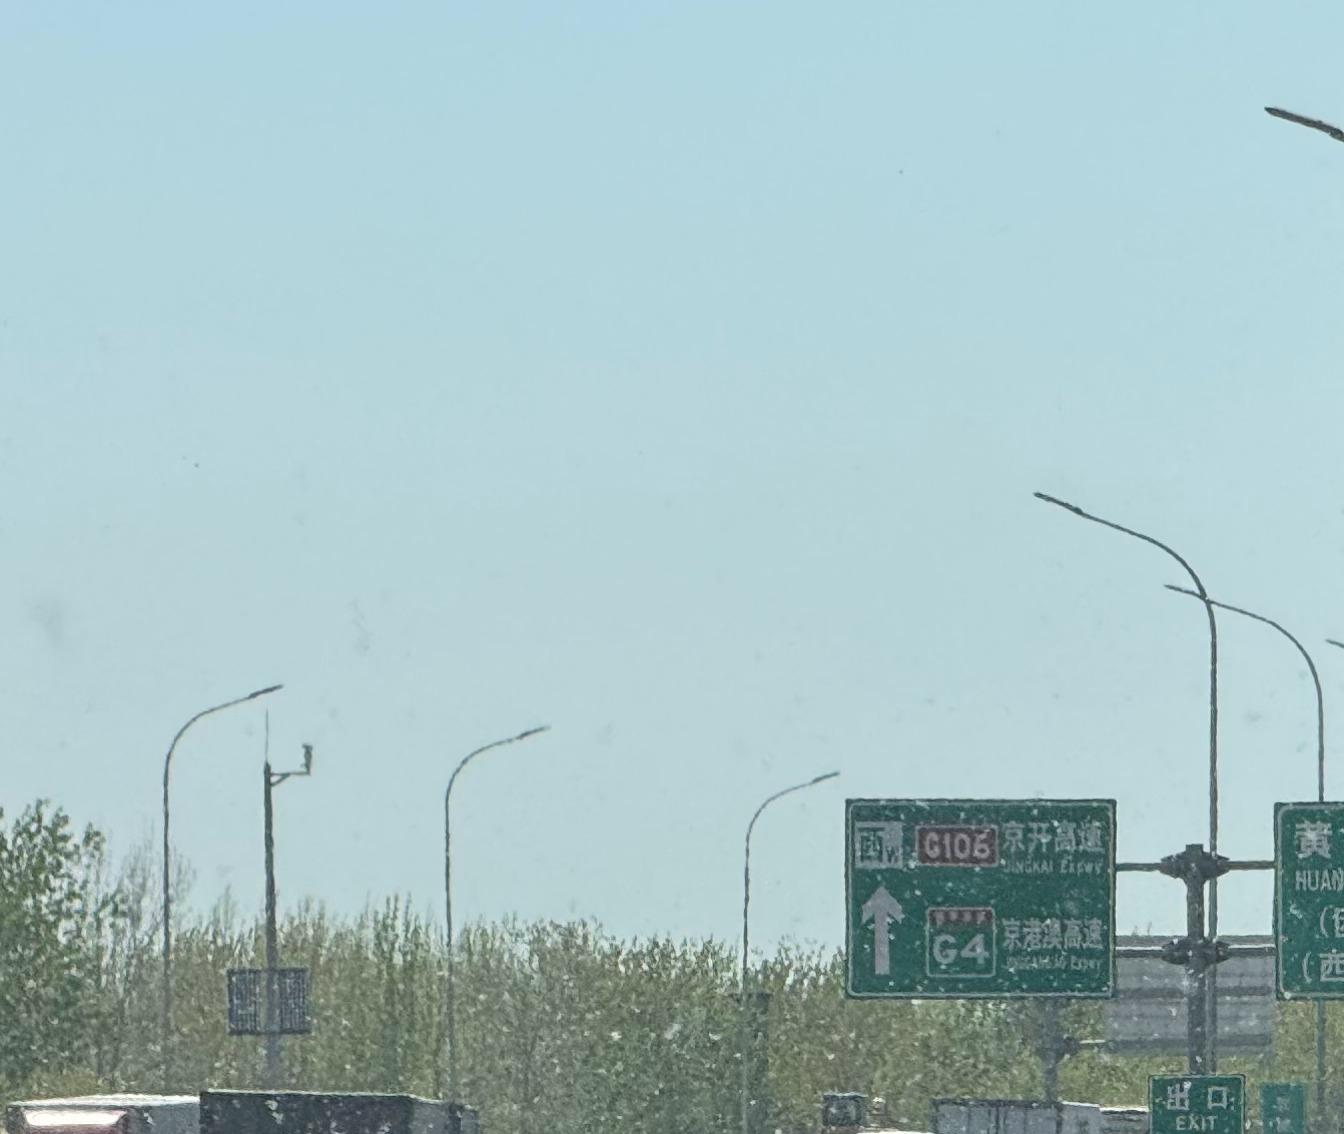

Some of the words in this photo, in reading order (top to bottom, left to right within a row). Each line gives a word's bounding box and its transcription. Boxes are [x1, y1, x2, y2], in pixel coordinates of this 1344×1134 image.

[1002, 820, 1104, 853] 京开高速
[933, 933, 990, 964] G4
[1167, 1084, 1228, 1110] 出口
[1176, 1115, 1217, 1130] EXIT
